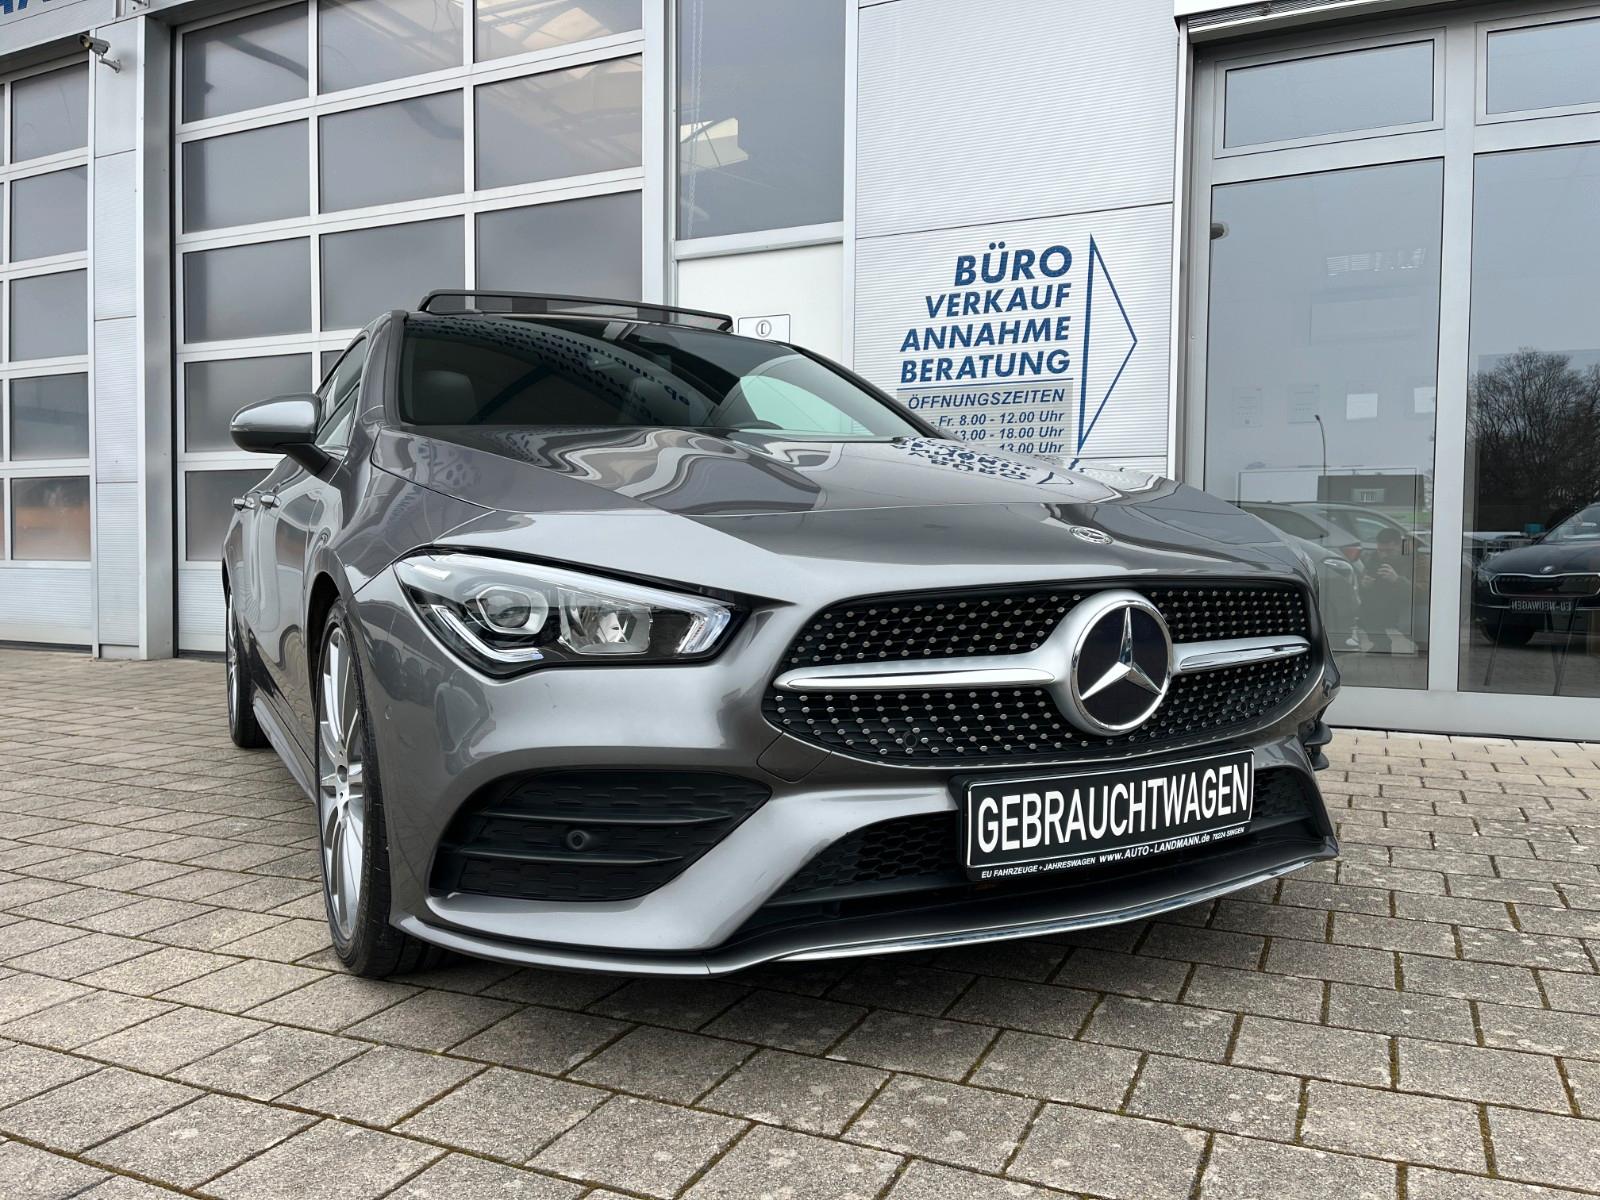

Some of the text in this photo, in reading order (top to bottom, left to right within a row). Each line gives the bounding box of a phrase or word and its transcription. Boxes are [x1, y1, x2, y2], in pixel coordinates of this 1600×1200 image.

[954, 241, 1073, 287] BÜRO
[925, 282, 1072, 319] VERKAUF
[900, 316, 1072, 352] ANNAHME
[900, 349, 1071, 384] BERATUNG
[908, 388, 1066, 410] ÖFFNUNGSZEITEN
[939, 415, 955, 427] Fr.
[960, 413, 987, 426] 8.00
[1000, 411, 1035, 424] 12.00
[1039, 410, 1065, 422] Uhr
[999, 427, 1035, 439] 18.00
[1039, 425, 1065, 438] Uhr
[1039, 441, 1065, 453] Uhr
[977, 762, 1249, 853] GEBRAUCHTWAGEN
[981, 870, 993, 879] EU
[993, 864, 1038, 877] FAHRZEUGE
[1044, 857, 1096, 871] JAHRESWAGEN
[1226, 826, 1245, 837] SINGEN
